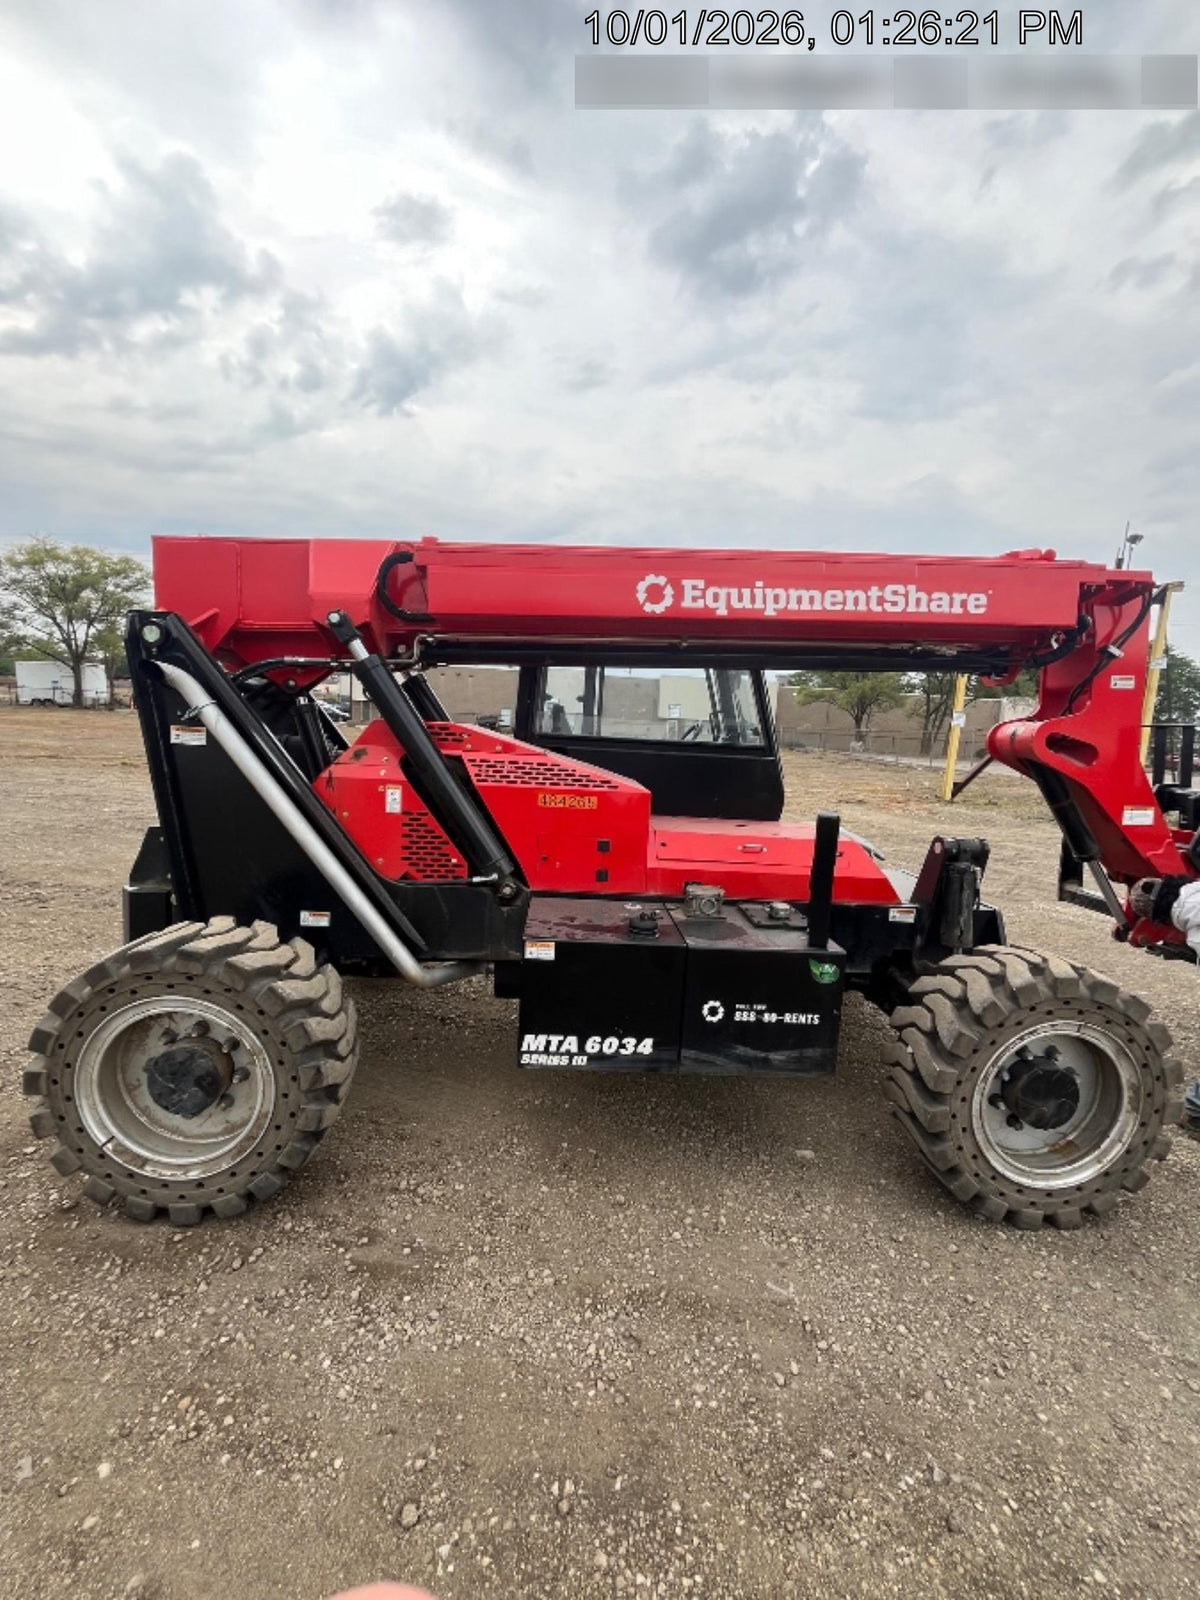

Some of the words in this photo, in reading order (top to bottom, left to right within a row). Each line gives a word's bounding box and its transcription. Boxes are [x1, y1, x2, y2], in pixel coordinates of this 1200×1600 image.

[681, 579, 988, 616] EquipmentShare
[520, 1034, 579, 1053] MTA
[584, 1036, 654, 1055] 6034
